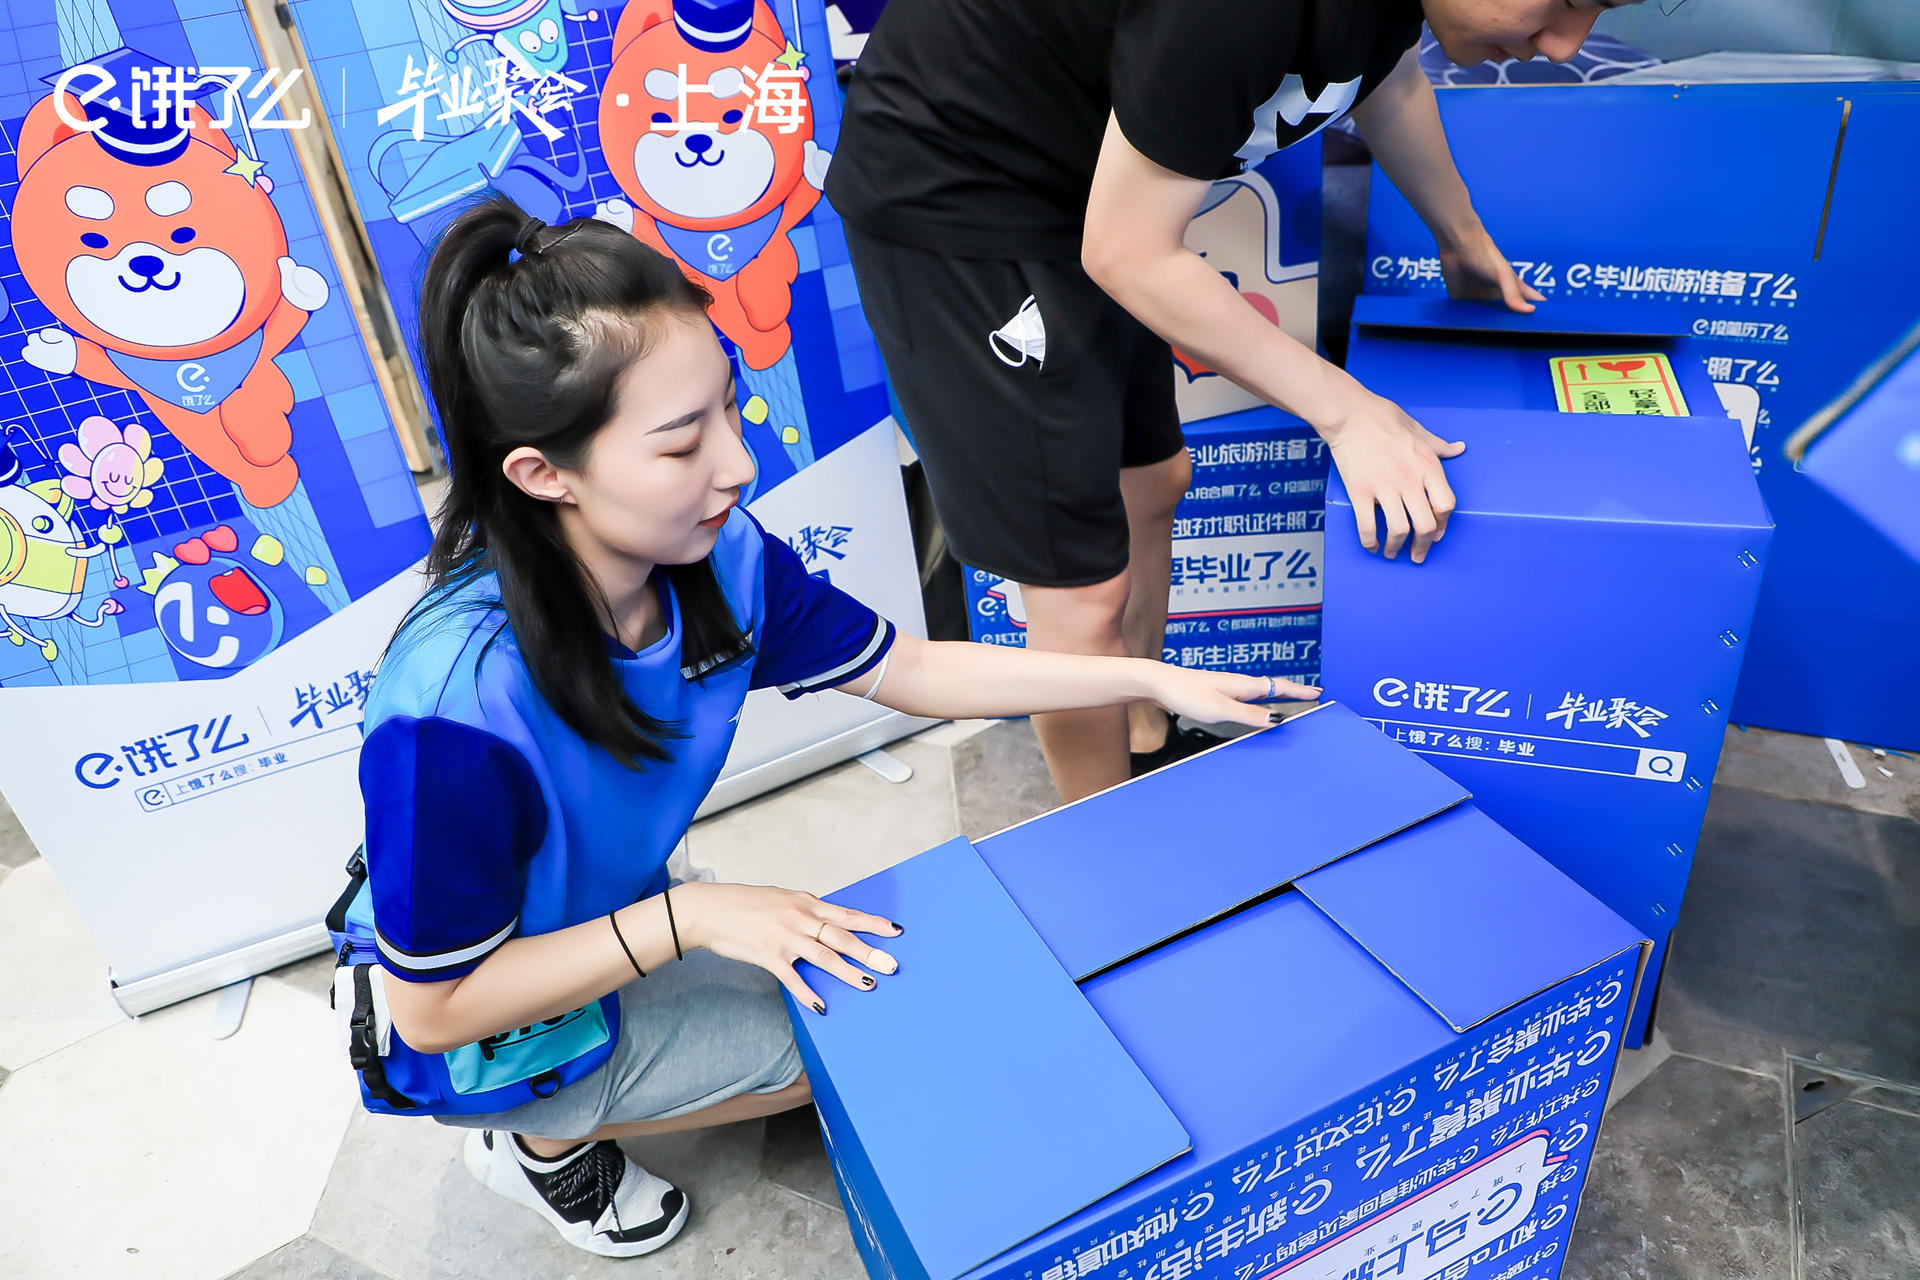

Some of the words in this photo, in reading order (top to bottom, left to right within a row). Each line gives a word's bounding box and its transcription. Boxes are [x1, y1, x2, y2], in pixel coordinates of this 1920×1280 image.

[1593, 264, 1798, 301] 毕业旅游准备了么
[1702, 356, 1780, 386] 照了么
[1181, 640, 1322, 667] 新生活开始了
[1413, 681, 1511, 719] 饿了么
[1545, 691, 1670, 738] 毕业聚会
[120, 714, 250, 777] 饿了么
[1433, 995, 1594, 1093] 毕业聚会了么
[1355, 1050, 1574, 1182] 毕业聚餐了么
[1490, 1088, 1579, 1147] 找工作了么
[1231, 1101, 1384, 1194] 论文过了么
